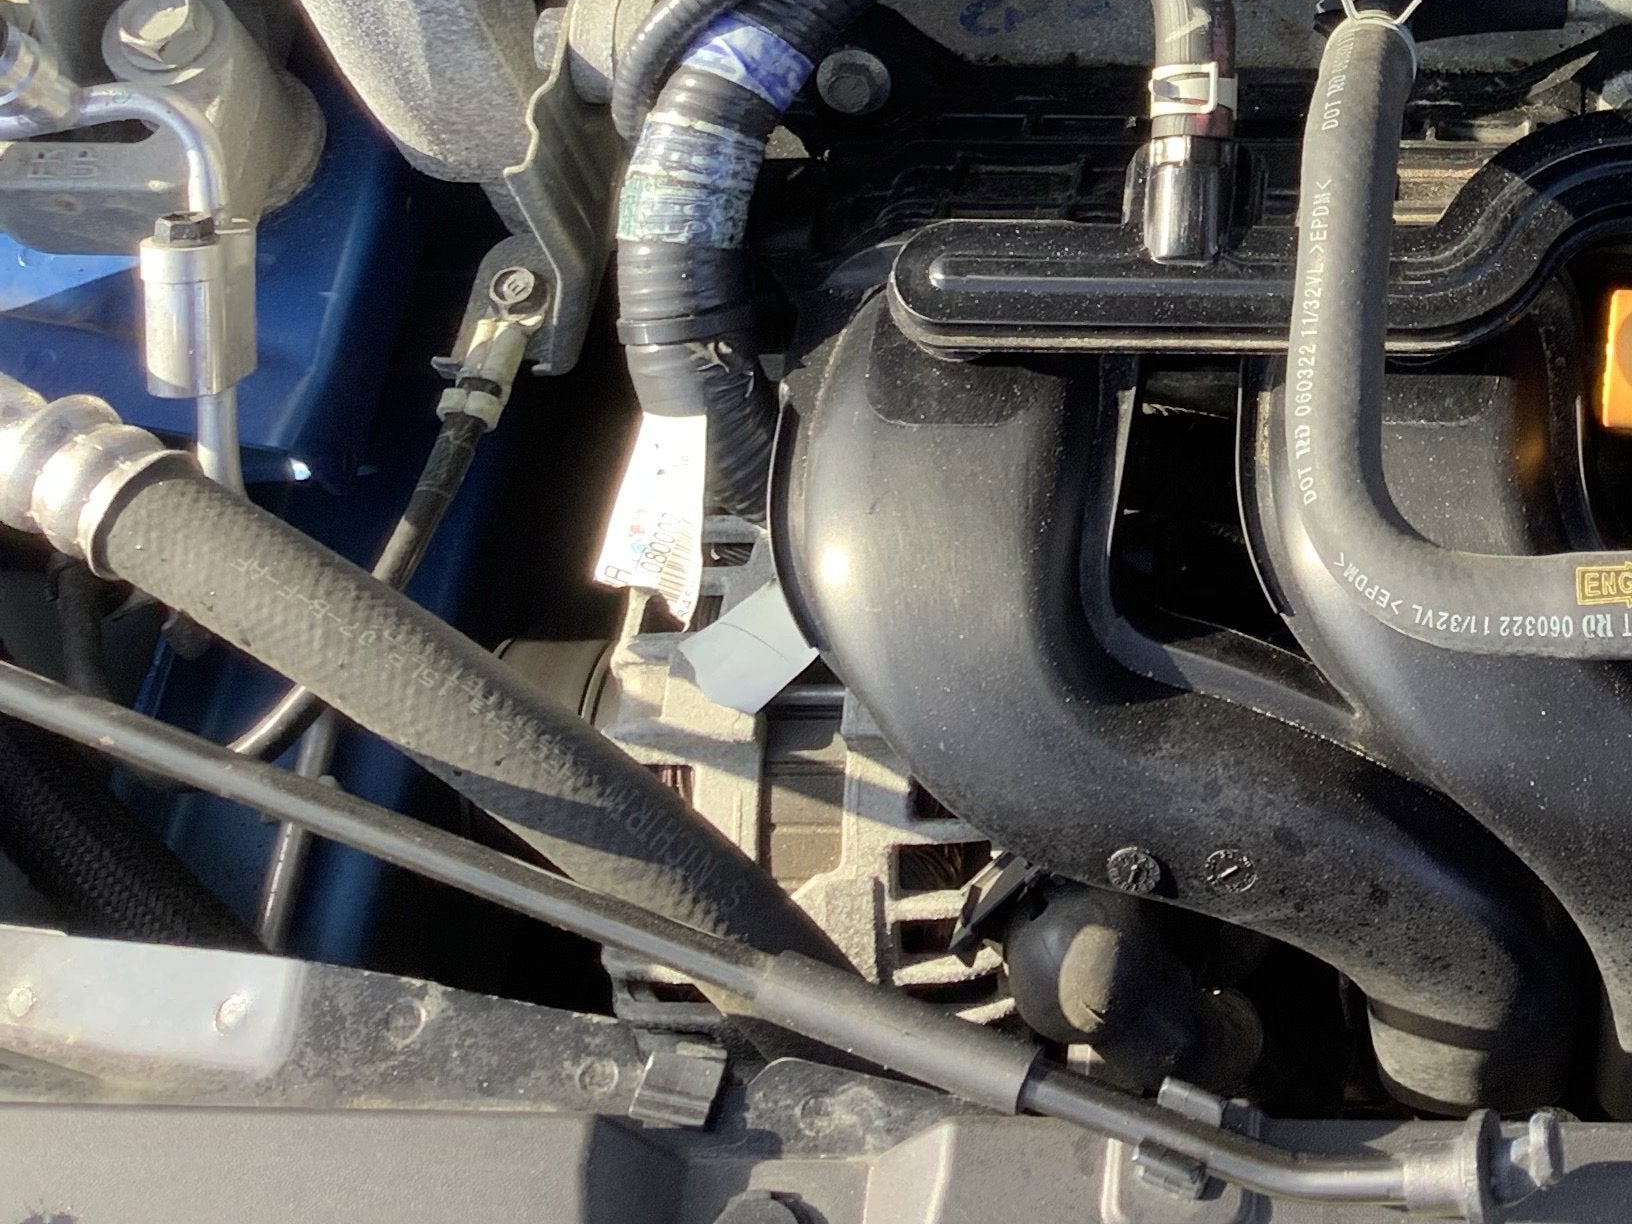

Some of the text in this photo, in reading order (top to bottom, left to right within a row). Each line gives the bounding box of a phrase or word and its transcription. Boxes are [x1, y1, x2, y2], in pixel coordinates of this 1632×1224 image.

[1322, 100, 1341, 131] DOT
[1310, 179, 1332, 255] >EPDM<
[1295, 343, 1316, 416] 060322
[1297, 466, 1318, 505] DOT
[1499, 614, 1573, 636] 060322
